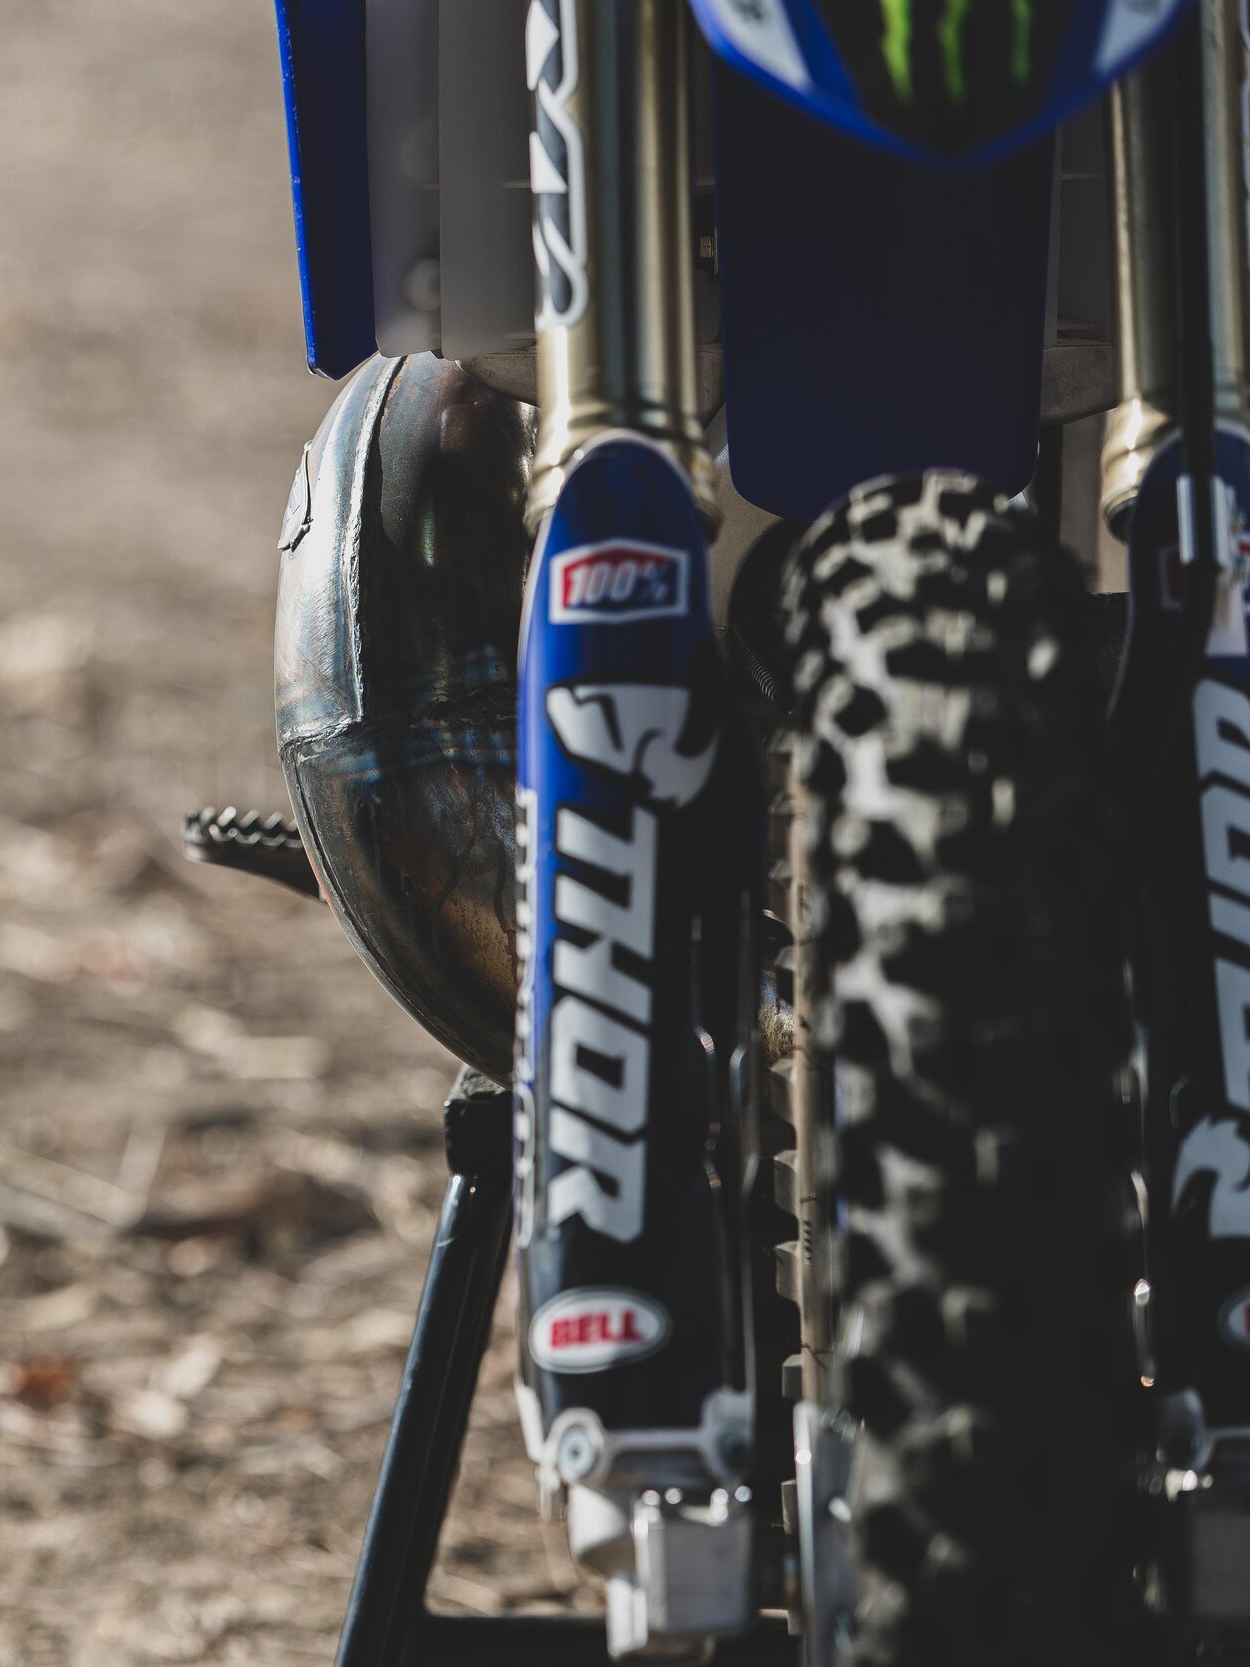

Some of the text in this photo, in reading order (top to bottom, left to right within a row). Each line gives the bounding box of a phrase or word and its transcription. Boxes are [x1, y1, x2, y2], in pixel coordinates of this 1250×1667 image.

[566, 559, 668, 607] 100%
[548, 803, 659, 1244] THOR
[551, 1308, 644, 1348] BELL
